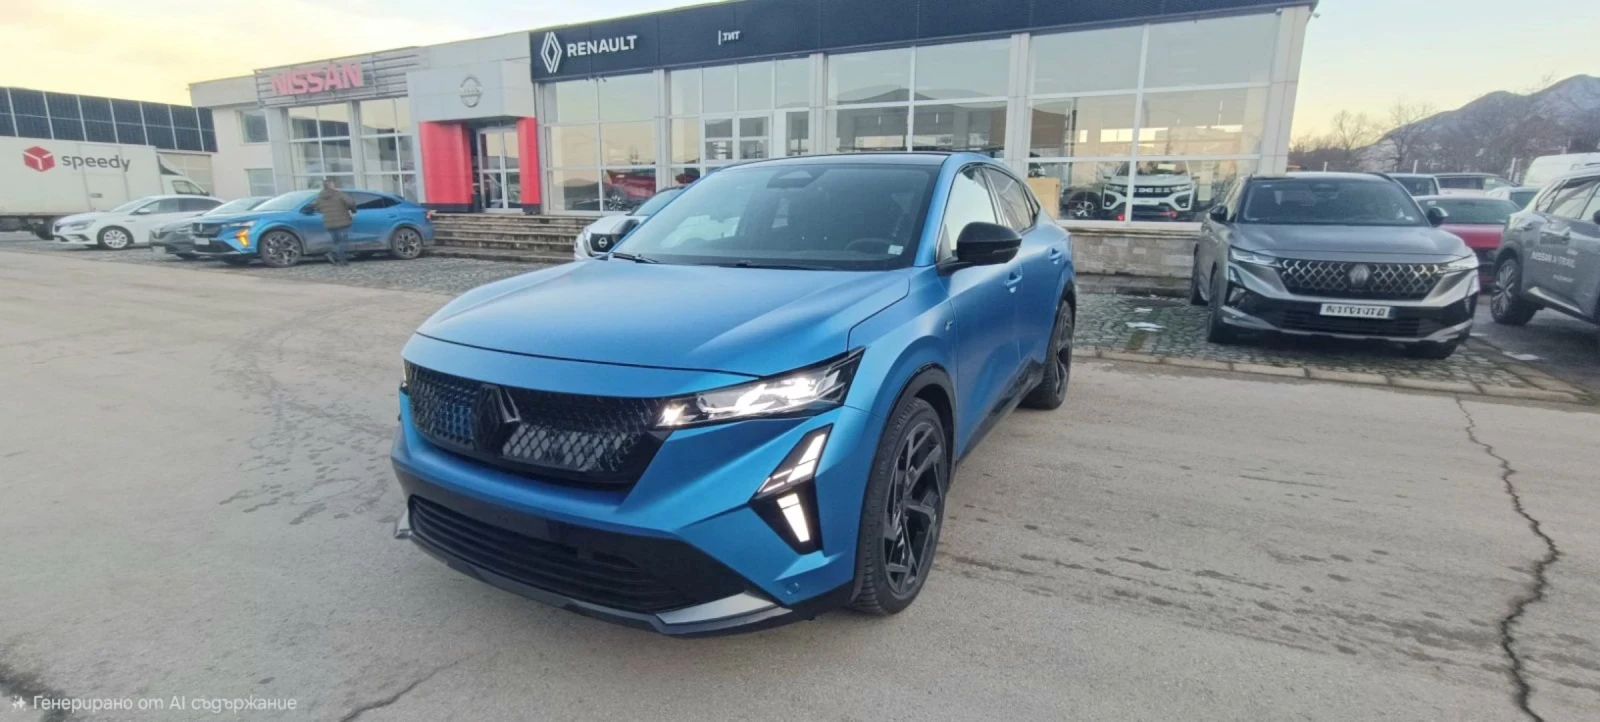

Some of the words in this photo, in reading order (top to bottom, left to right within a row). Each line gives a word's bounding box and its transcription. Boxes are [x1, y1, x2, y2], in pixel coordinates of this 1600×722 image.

[567, 35, 637, 57] RENAULT
[271, 63, 363, 95] NISSAN
[61, 155, 131, 172] speedy
